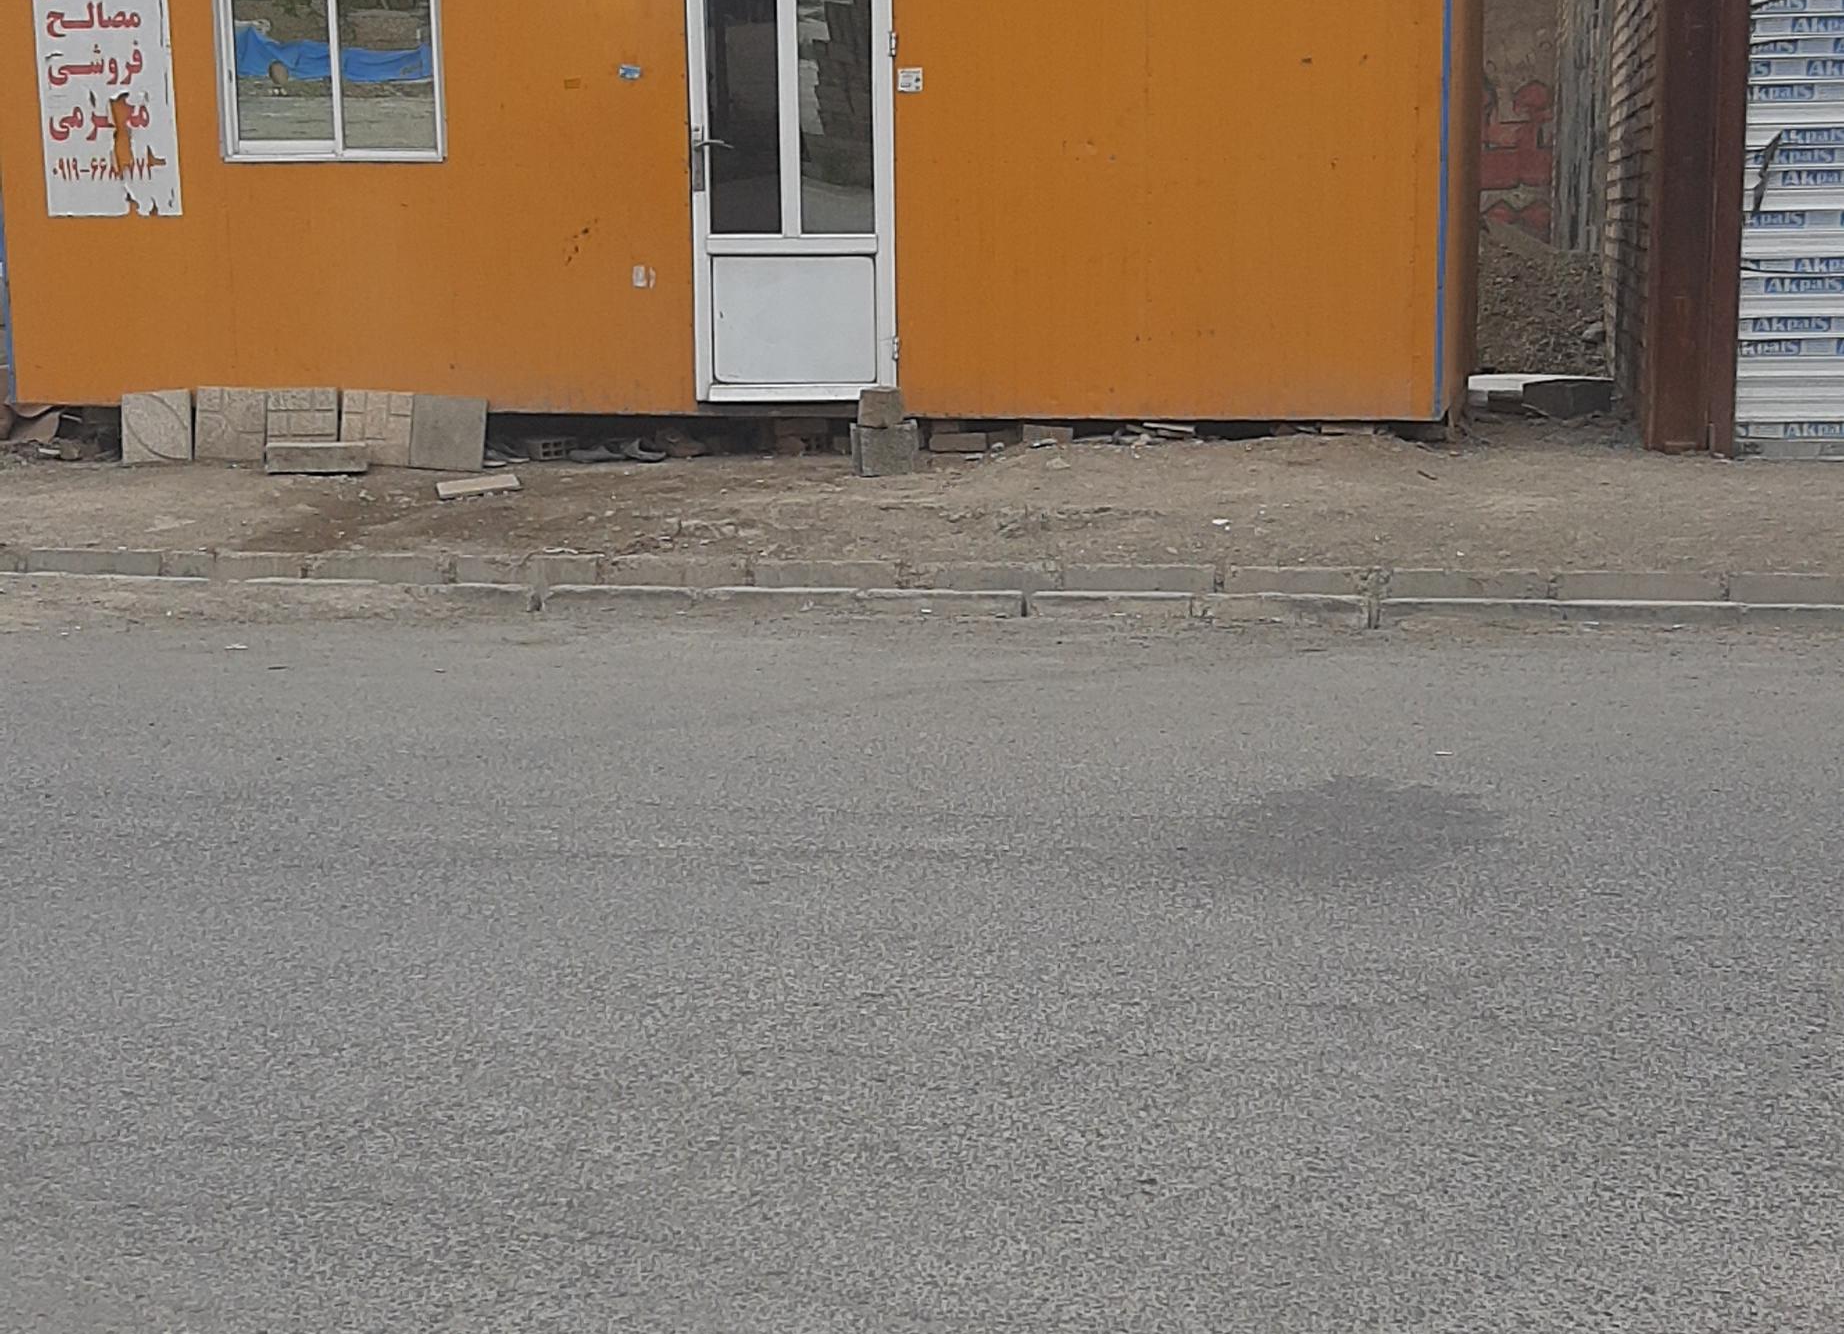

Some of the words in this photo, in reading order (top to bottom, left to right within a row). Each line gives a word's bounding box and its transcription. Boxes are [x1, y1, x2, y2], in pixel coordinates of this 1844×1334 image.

[46, 0, 141, 37] مصالح
[47, 41, 144, 86] فروشی
[49, 103, 150, 141] مرمی
